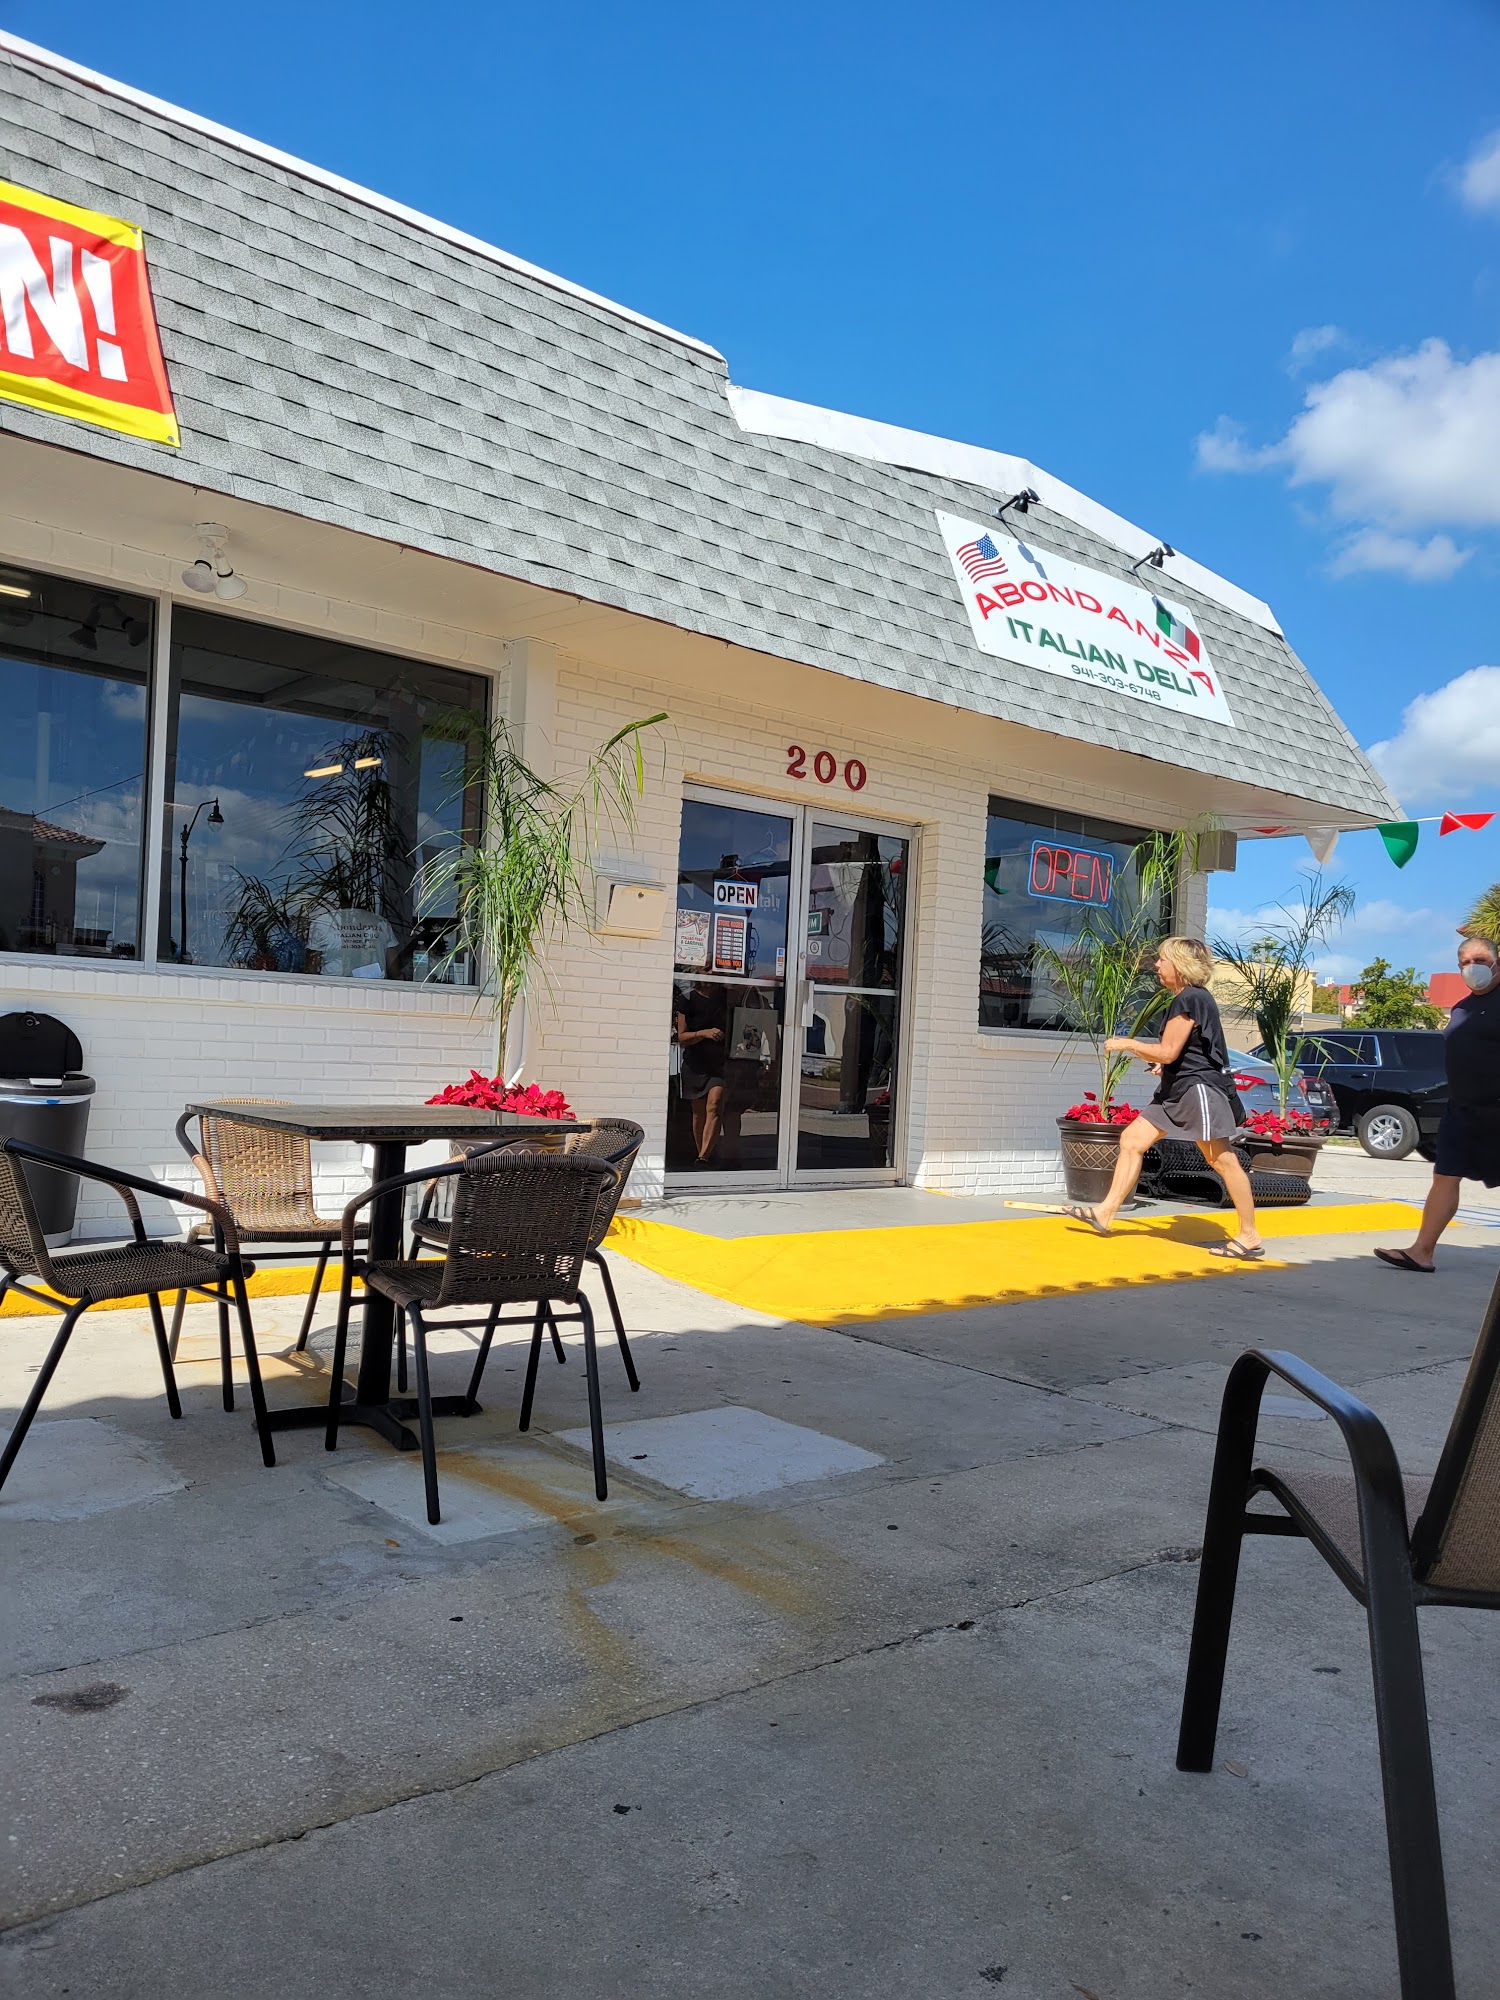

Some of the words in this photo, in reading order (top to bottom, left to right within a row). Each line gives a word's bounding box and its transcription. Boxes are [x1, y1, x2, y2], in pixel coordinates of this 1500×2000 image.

[975, 580, 1216, 697] ABONDANZA
[1006, 616, 1128, 674] ITALIAN
[1134, 659, 1198, 697] DELI
[1071, 664, 1161, 701] 941-303-6748
[786, 745, 867, 791] 200
[717, 884, 755, 905] OPEN
[1032, 846, 1111, 902] OPEN
